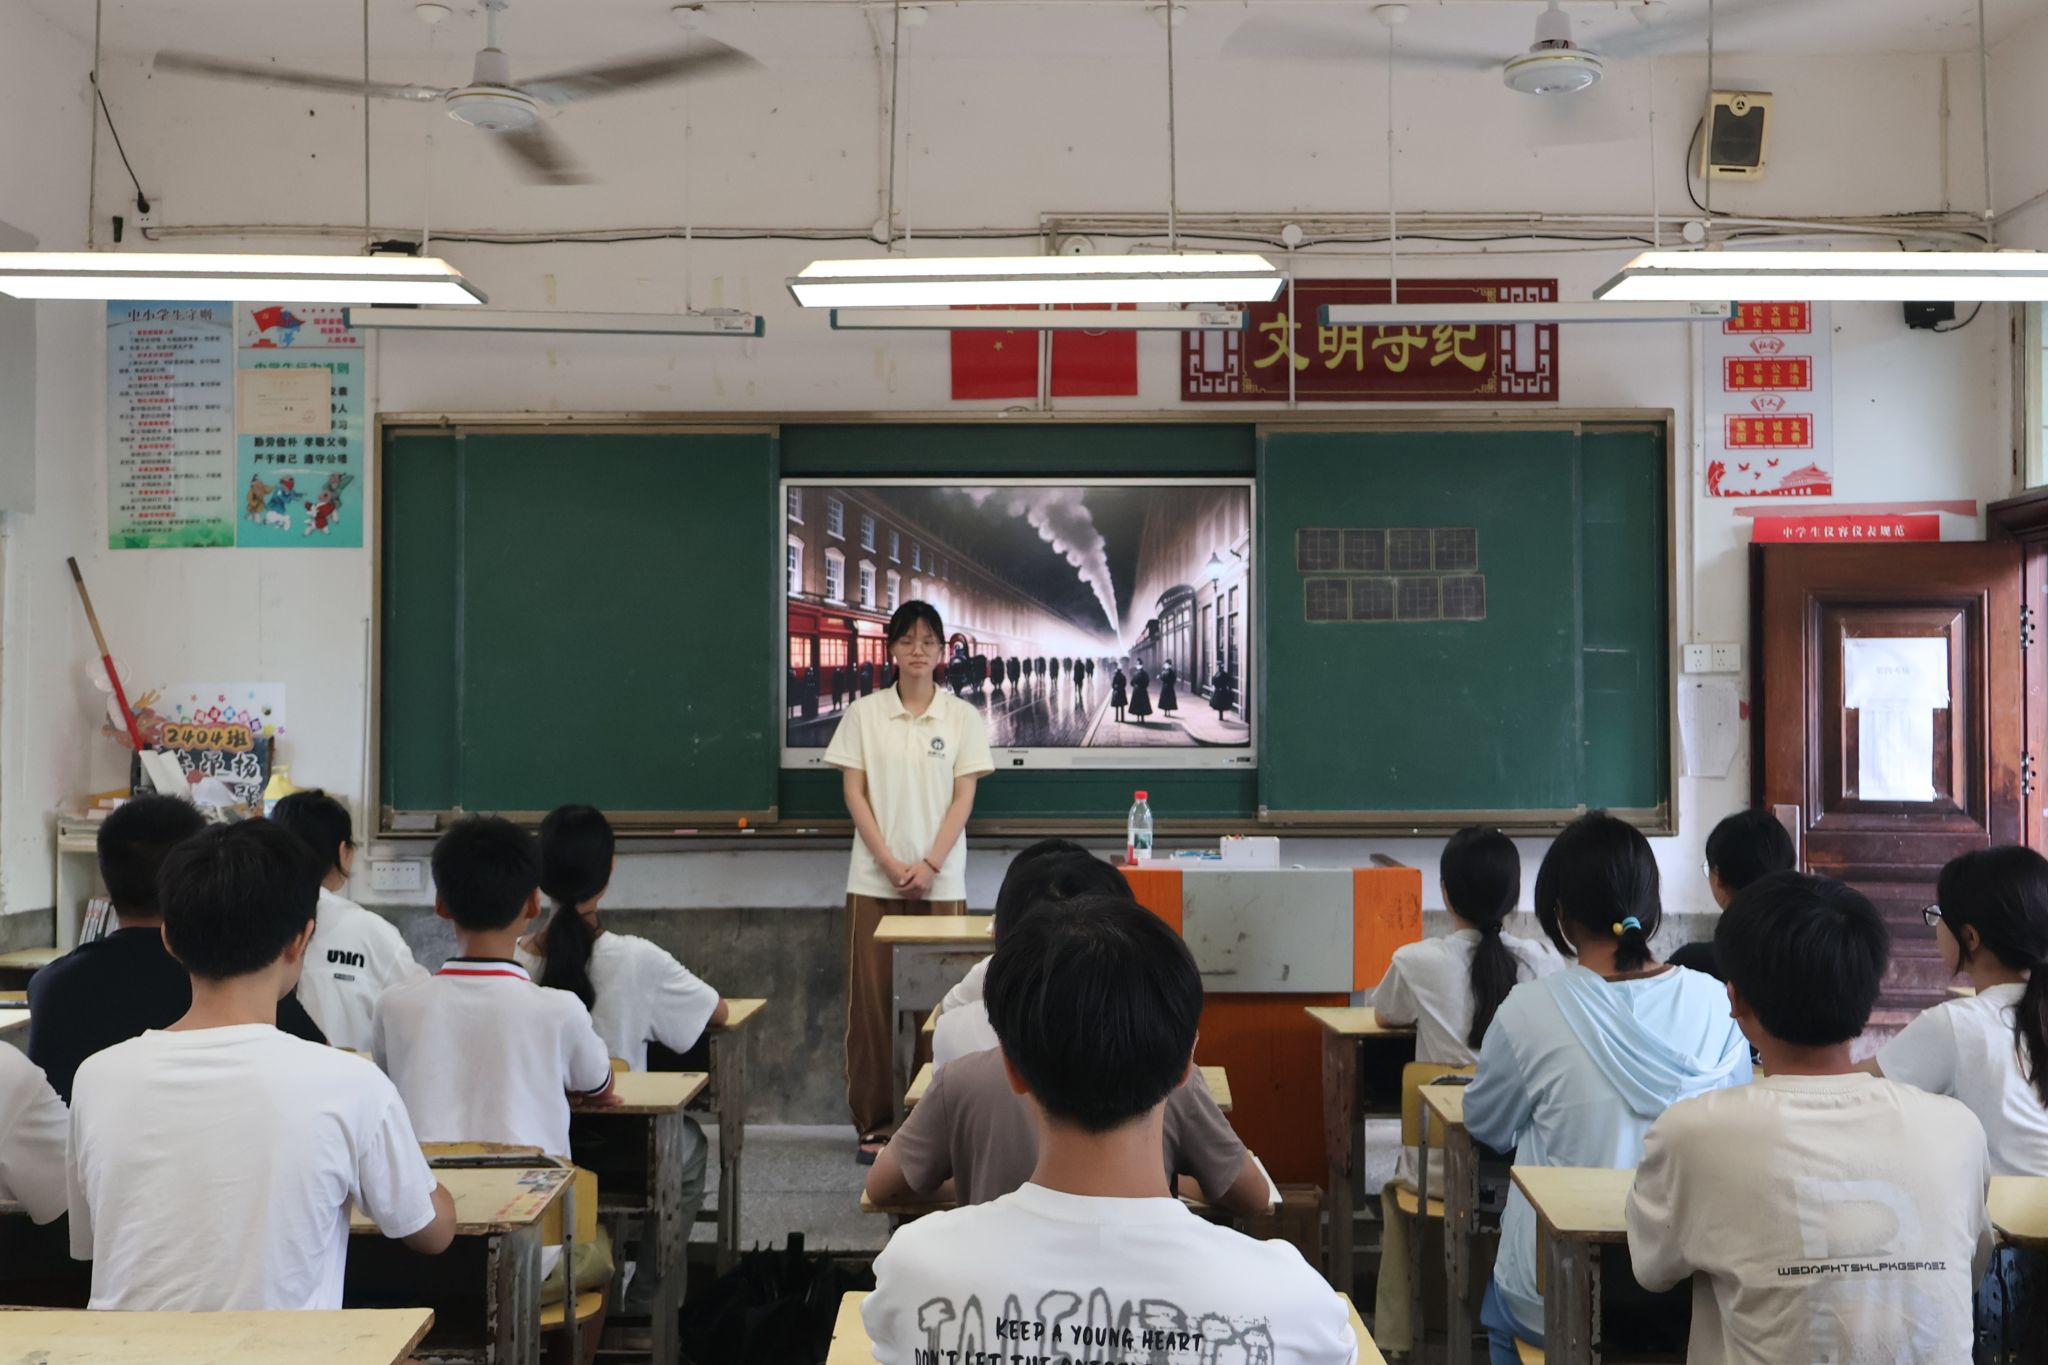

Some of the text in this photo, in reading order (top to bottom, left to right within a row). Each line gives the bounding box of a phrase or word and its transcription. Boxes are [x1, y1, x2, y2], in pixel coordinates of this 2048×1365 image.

[128, 308, 213, 322] 中小学生守则
[1253, 312, 1487, 373] 文明守纪
[304, 437, 348, 448] 孝敬父母
[254, 453, 298, 464] 严于律己
[1783, 524, 1905, 538] 中学生仪容仪表规范
[167, 728, 248, 748] 2404班
[996, 1316, 1205, 1352] KEEP A YOUNG HEART
